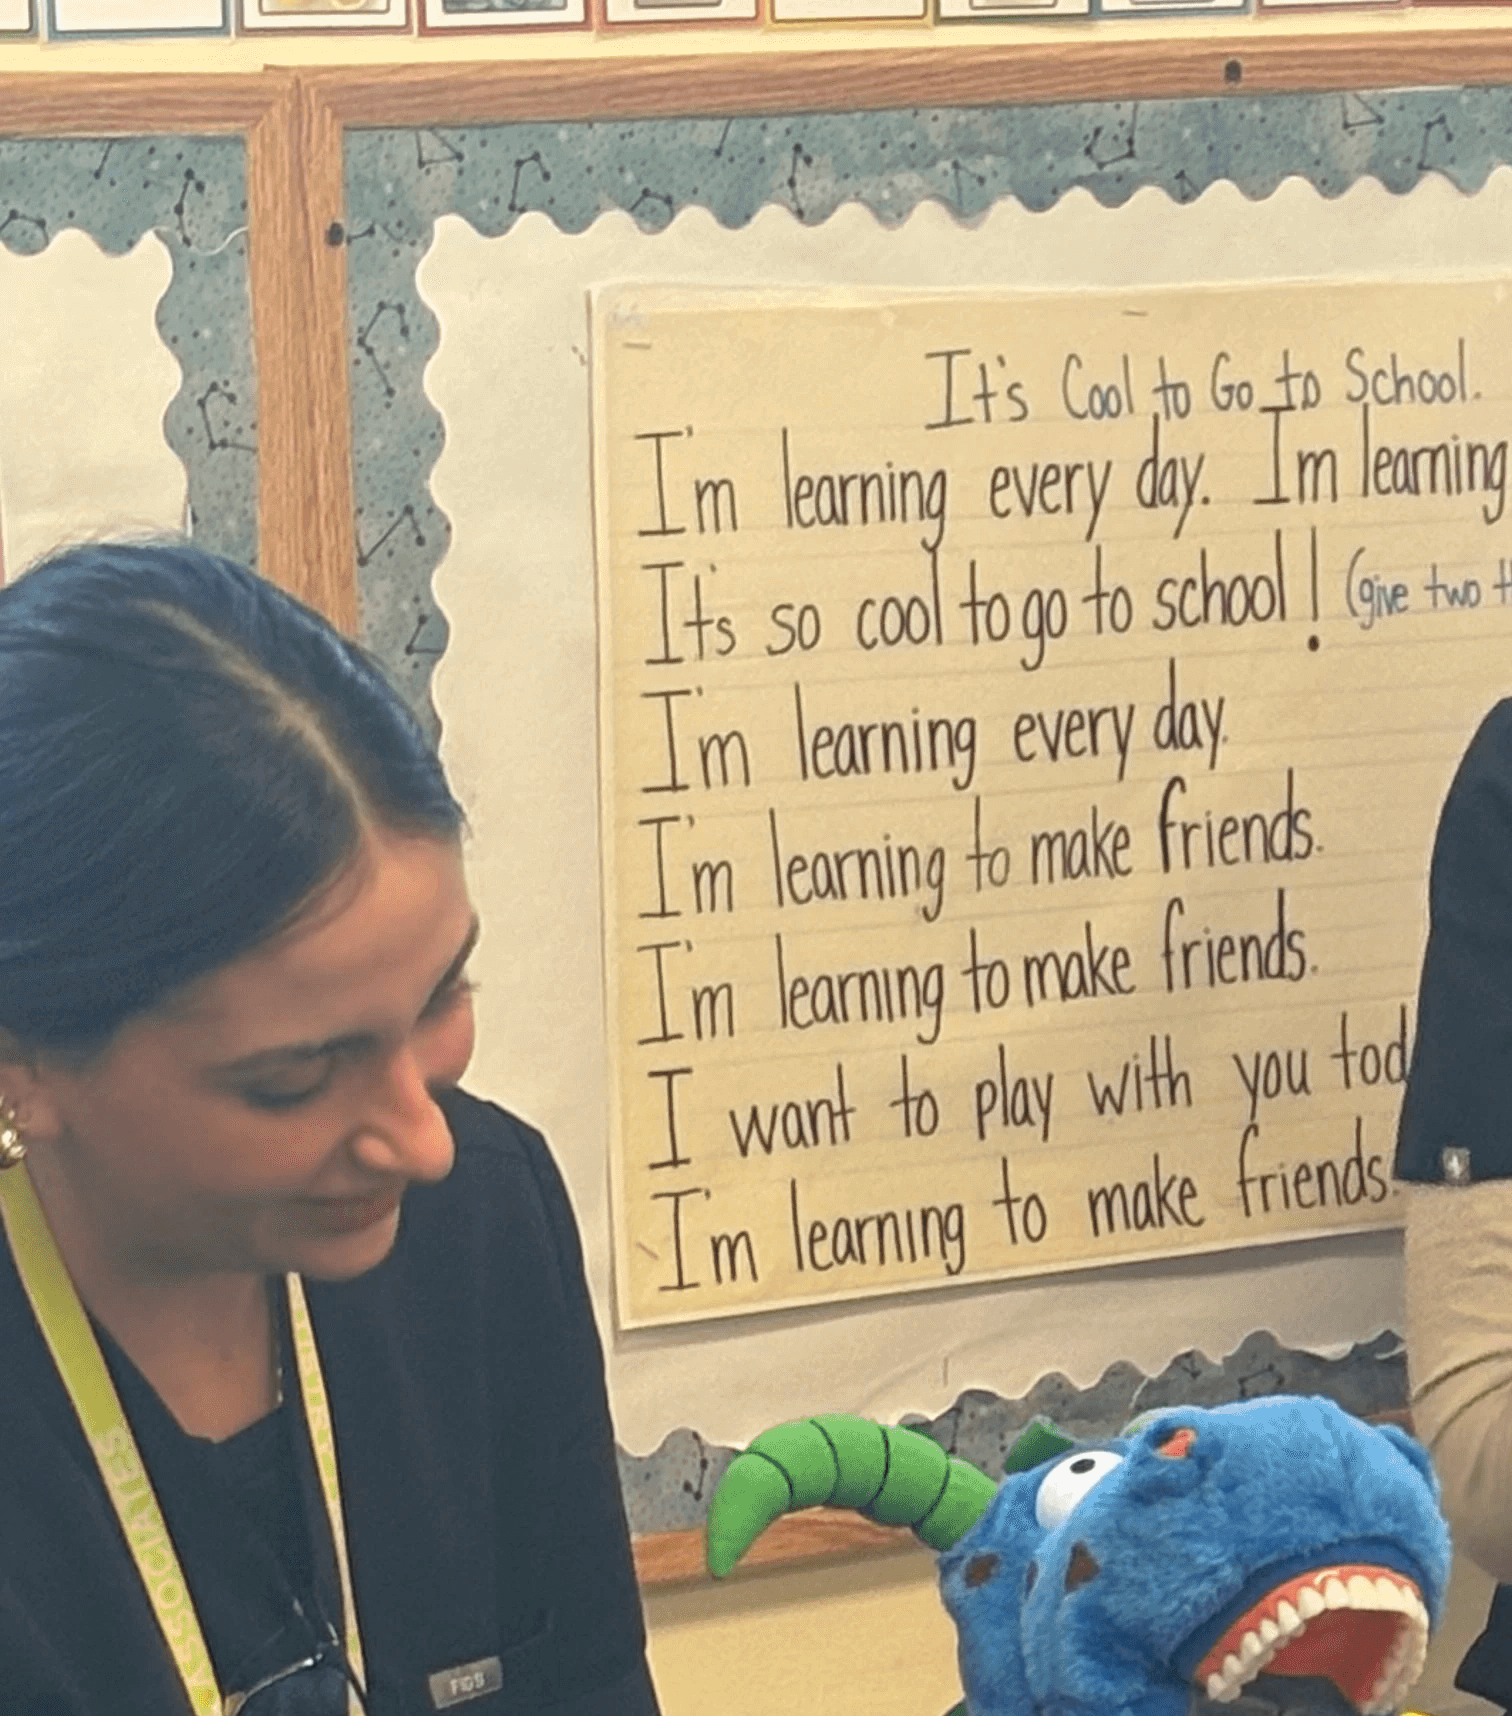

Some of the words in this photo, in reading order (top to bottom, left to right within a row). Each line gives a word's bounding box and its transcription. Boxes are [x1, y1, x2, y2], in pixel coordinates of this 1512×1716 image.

[924, 348, 1029, 430] It's
[1062, 353, 1136, 420] Cool
[1153, 357, 1192, 421] to
[1211, 352, 1255, 411] Go
[1275, 349, 1322, 411] to
[1345, 336, 1484, 405] School.
[634, 425, 739, 535] I'm
[782, 426, 948, 553] learning
[989, 460, 1113, 543] every
[1136, 412, 1212, 540] day.
[1362, 402, 1509, 526] learning
[640, 560, 737, 665] It's
[766, 602, 822, 657] so
[857, 548, 943, 652] cool
[959, 559, 1011, 647] to
[1021, 587, 1069, 672] go
[1081, 544, 1133, 635] to
[1344, 546, 1409, 631] (give
[1423, 563, 1483, 608] two
[640, 685, 751, 794] I'm
[794, 681, 978, 792] learning
[1013, 703, 1136, 783] every
[1154, 656, 1231, 771] day.
[638, 814, 734, 919] I'm
[769, 807, 946, 923] learning
[965, 795, 1011, 893] to
[1030, 805, 1134, 885] make
[1159, 767, 1325, 875] friends.
[636, 939, 734, 1046] I'm
[775, 932, 945, 1045] learning
[961, 927, 1010, 1014] to
[1023, 920, 1138, 1008] make
[1161, 887, 1320, 994] friends.
[648, 1067, 694, 1170] I
[728, 1061, 857, 1158] want
[889, 1053, 940, 1138] to
[974, 1042, 1055, 1143] play
[1087, 1034, 1194, 1116] with
[1232, 1047, 1314, 1123] you
[650, 1188, 758, 1292] I'm
[791, 1178, 966, 1276] learning
[992, 1156, 1048, 1246] to
[1088, 1153, 1206, 1238] make
[1236, 1115, 1401, 1219] friends.
